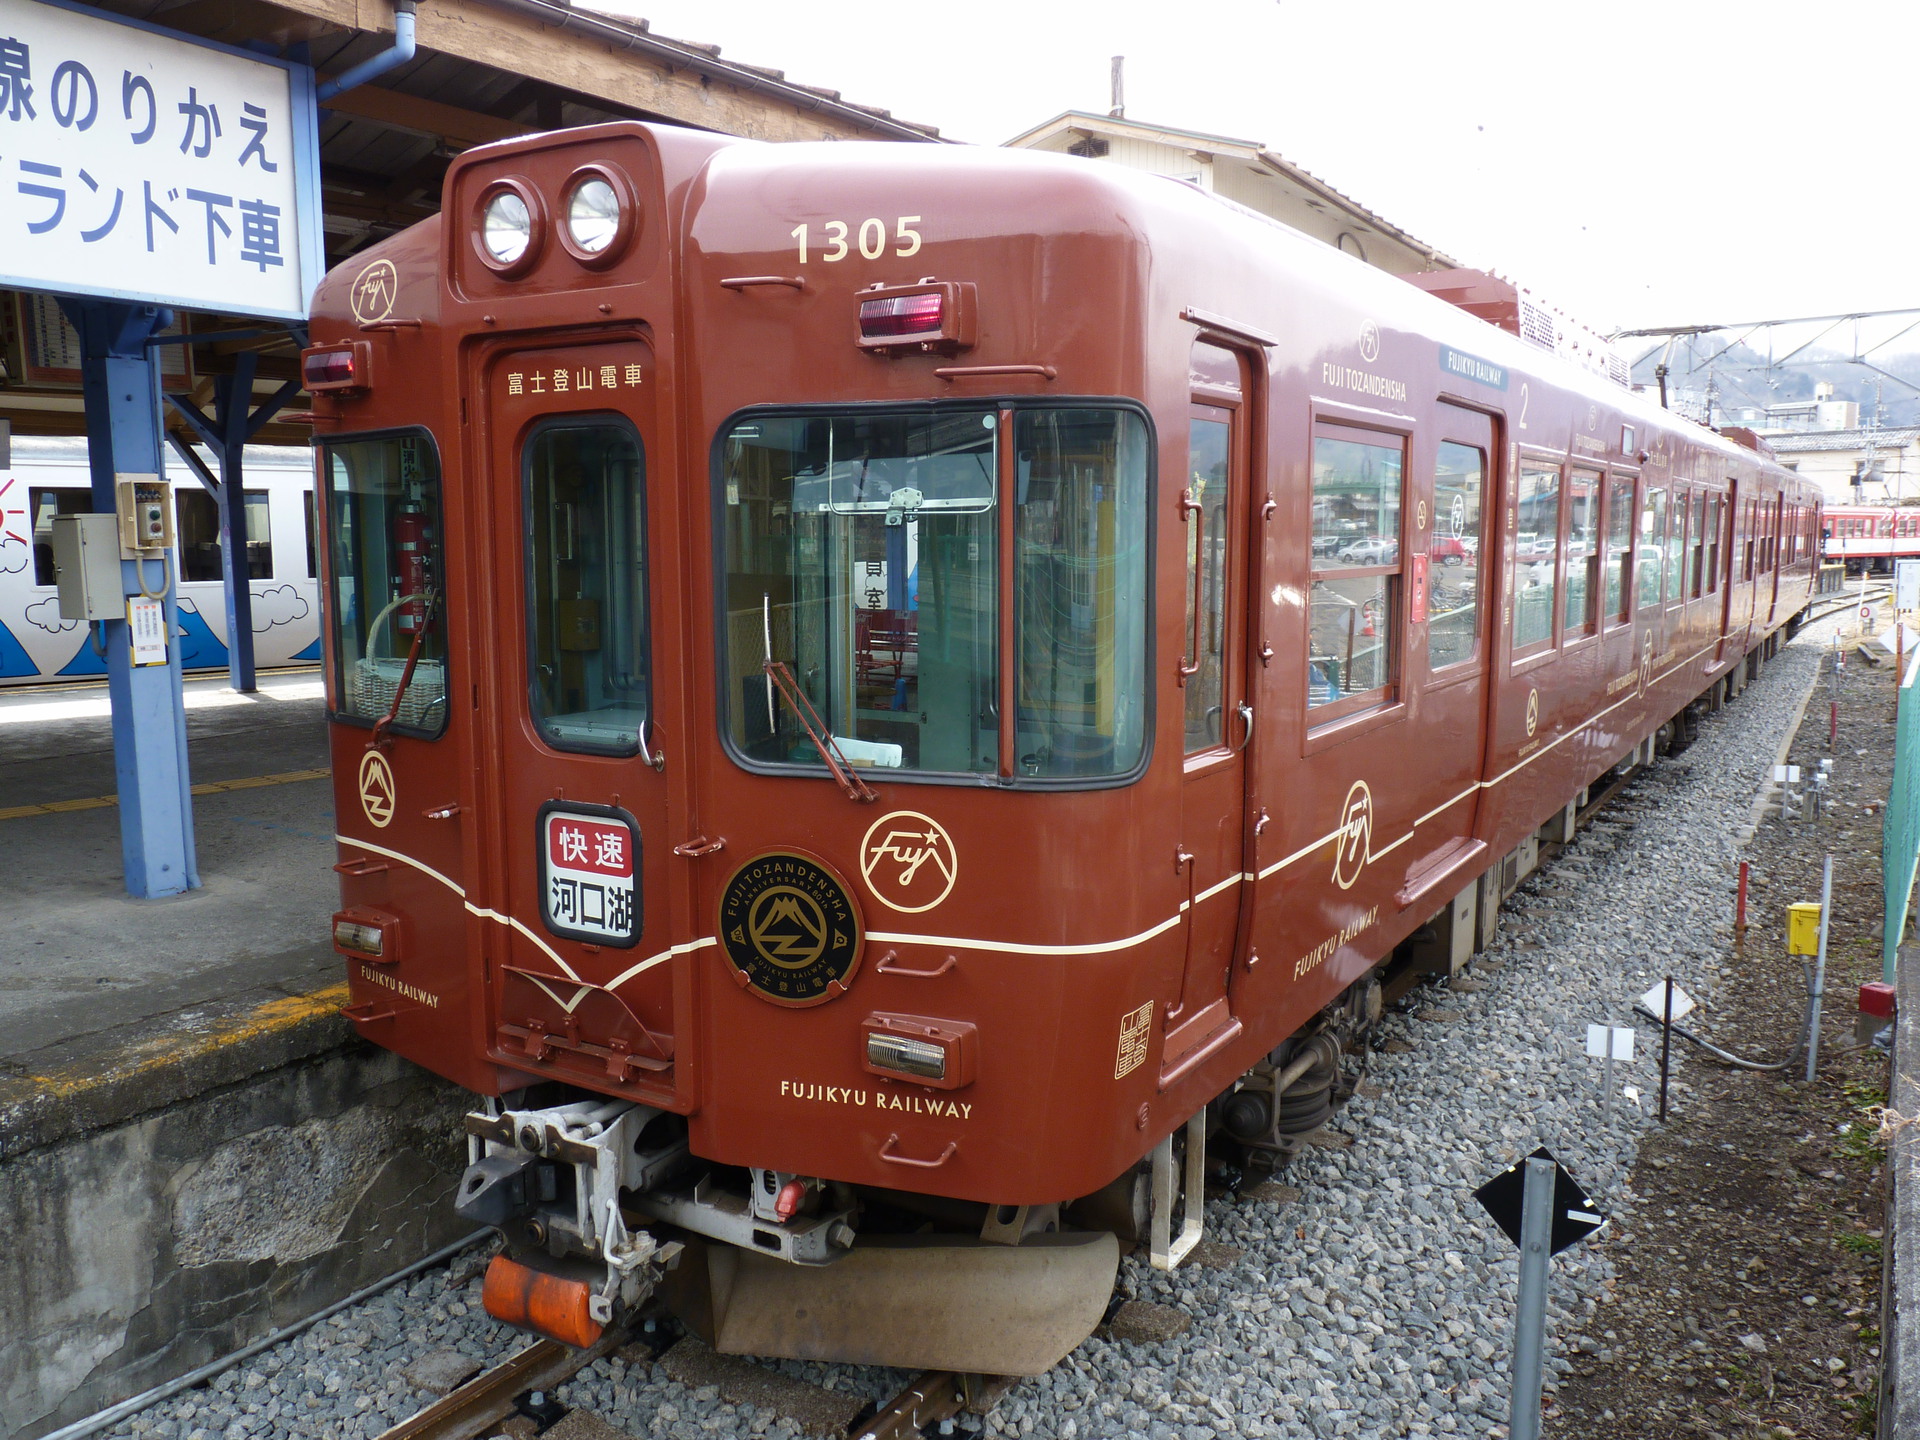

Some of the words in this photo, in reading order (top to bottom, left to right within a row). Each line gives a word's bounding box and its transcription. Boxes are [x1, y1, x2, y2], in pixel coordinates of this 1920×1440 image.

[0, 155, 284, 273] ランド下車
[790, 215, 922, 264] 1305
[507, 363, 642, 395] 富士登山電車
[1323, 362, 1344, 387] FUJI
[1346, 368, 1407, 402] TOZANDENSHA
[1448, 351, 1475, 377] FUJIKYU
[1477, 360, 1502, 386] RAILWAY
[1519, 382, 1529, 430] 2
[558, 826, 625, 870] 快速
[551, 876, 635, 933] 河口湖
[744, 876, 812, 906] ANNIVERSARY
[1294, 934, 1338, 982] FUJIKYU
[1338, 904, 1379, 949] RAILWAY
[361, 965, 396, 991] FUJIKYU
[398, 981, 439, 1009] RAILWAY
[753, 955, 788, 979] FUJIKYU
[792, 958, 828, 980] RAILWAY
[780, 1080, 867, 1106] FUJIKYU
[876, 1092, 972, 1120] RAILWAY
